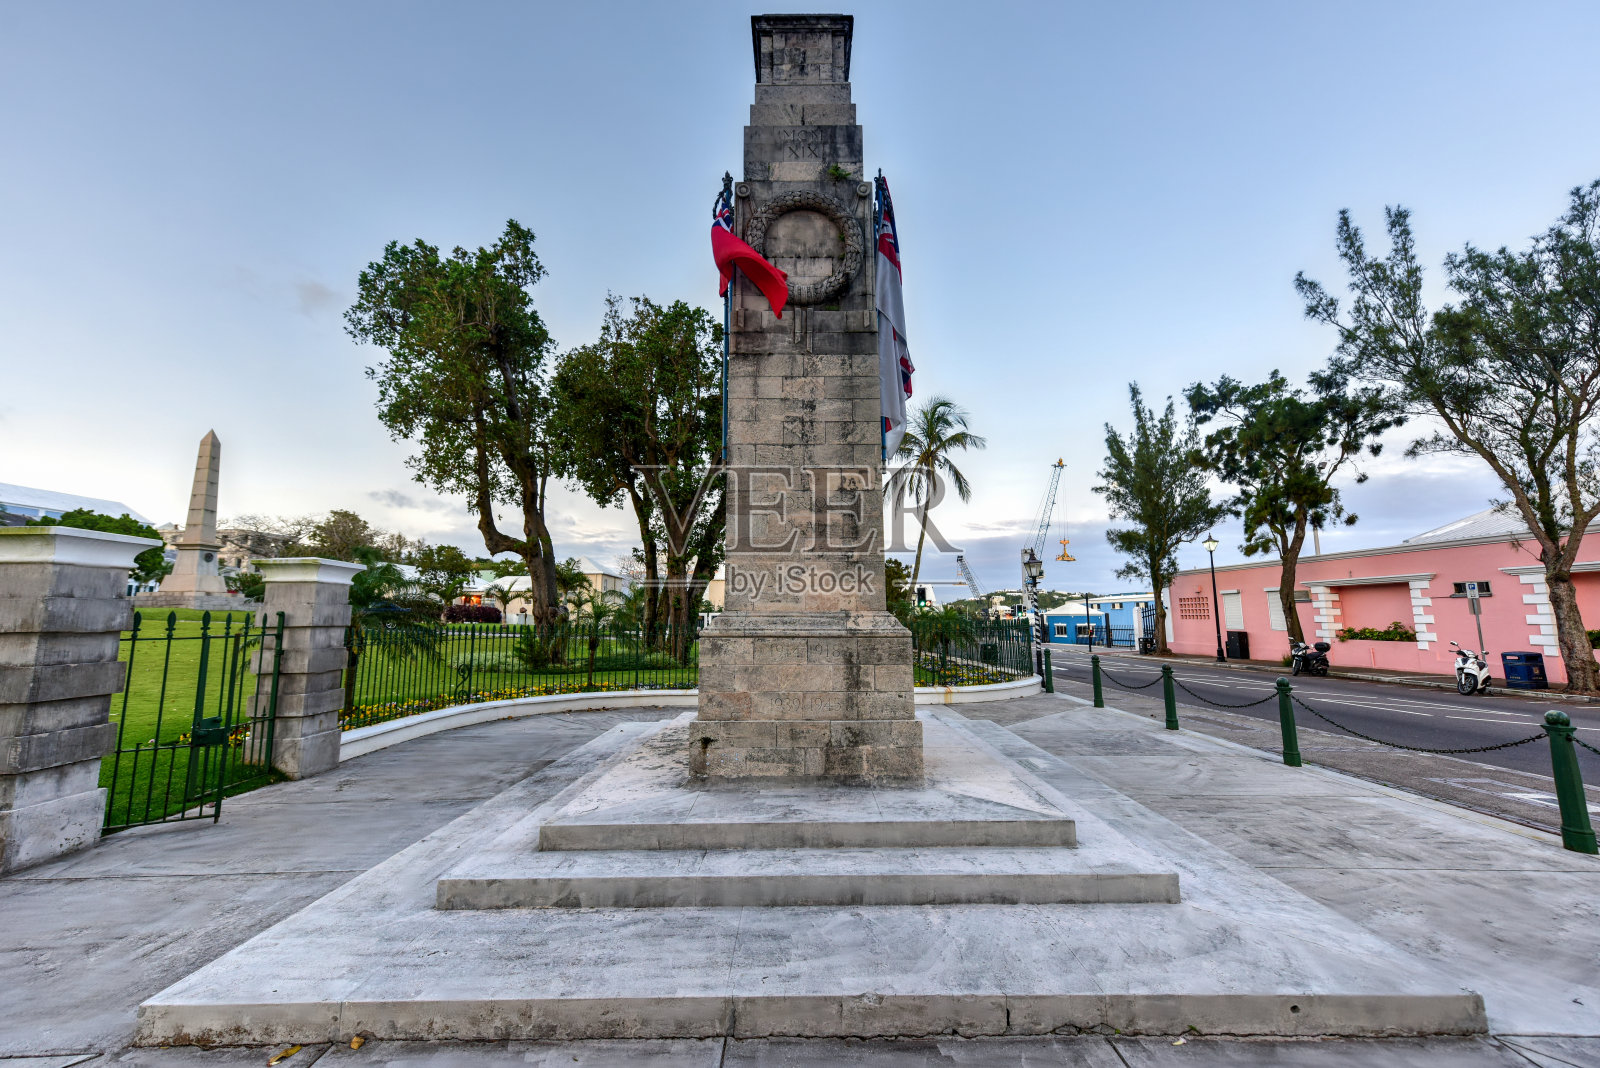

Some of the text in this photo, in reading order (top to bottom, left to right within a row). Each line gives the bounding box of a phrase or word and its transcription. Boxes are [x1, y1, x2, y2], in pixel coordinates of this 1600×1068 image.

[789, 146, 818, 158] XIX
[770, 698, 841, 711] 1939 1945
